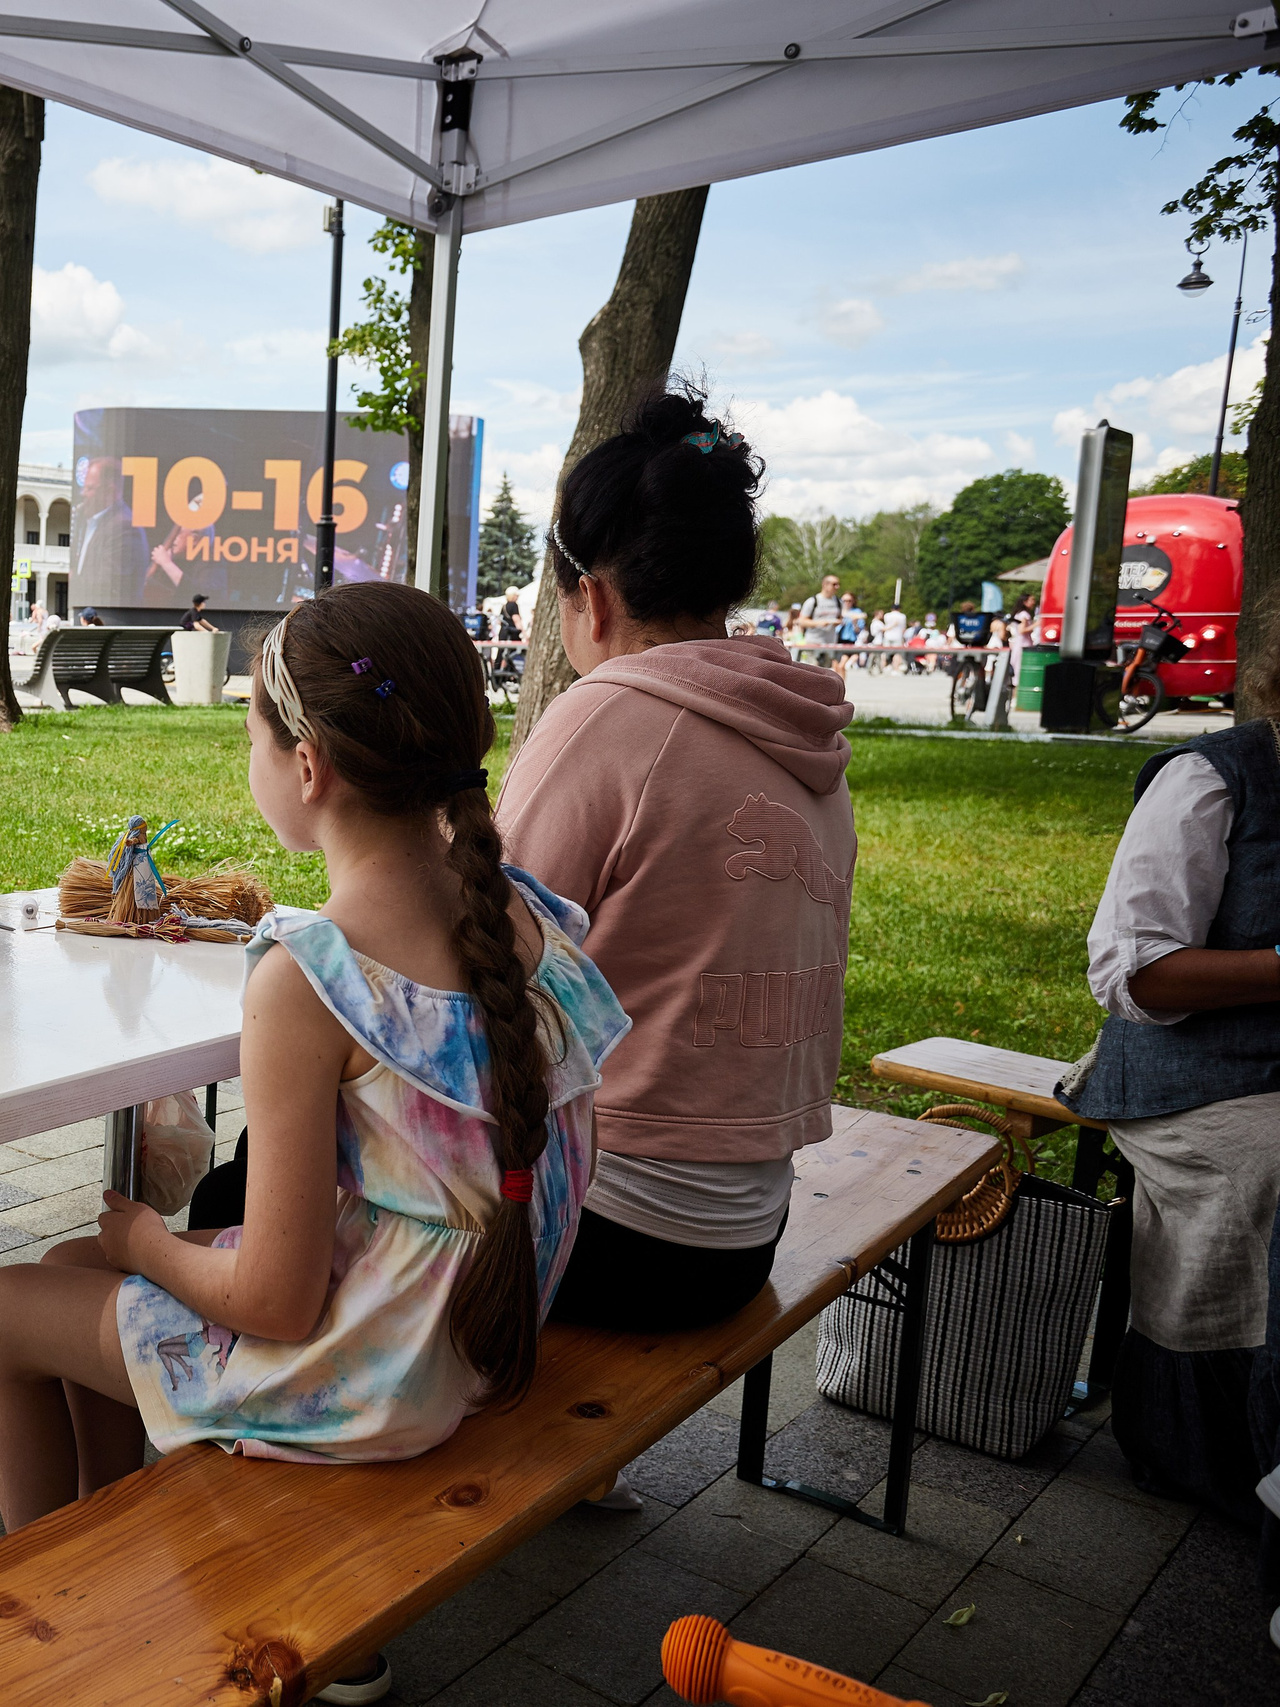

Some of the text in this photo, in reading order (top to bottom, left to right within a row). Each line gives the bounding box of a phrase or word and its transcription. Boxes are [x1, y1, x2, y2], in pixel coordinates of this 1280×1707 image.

[122, 456, 368, 533] 10-16
[186, 536, 299, 563] ИЮНЯ
[692, 963, 841, 1048] PUMA
[765, 1654, 879, 1703] Scooter
